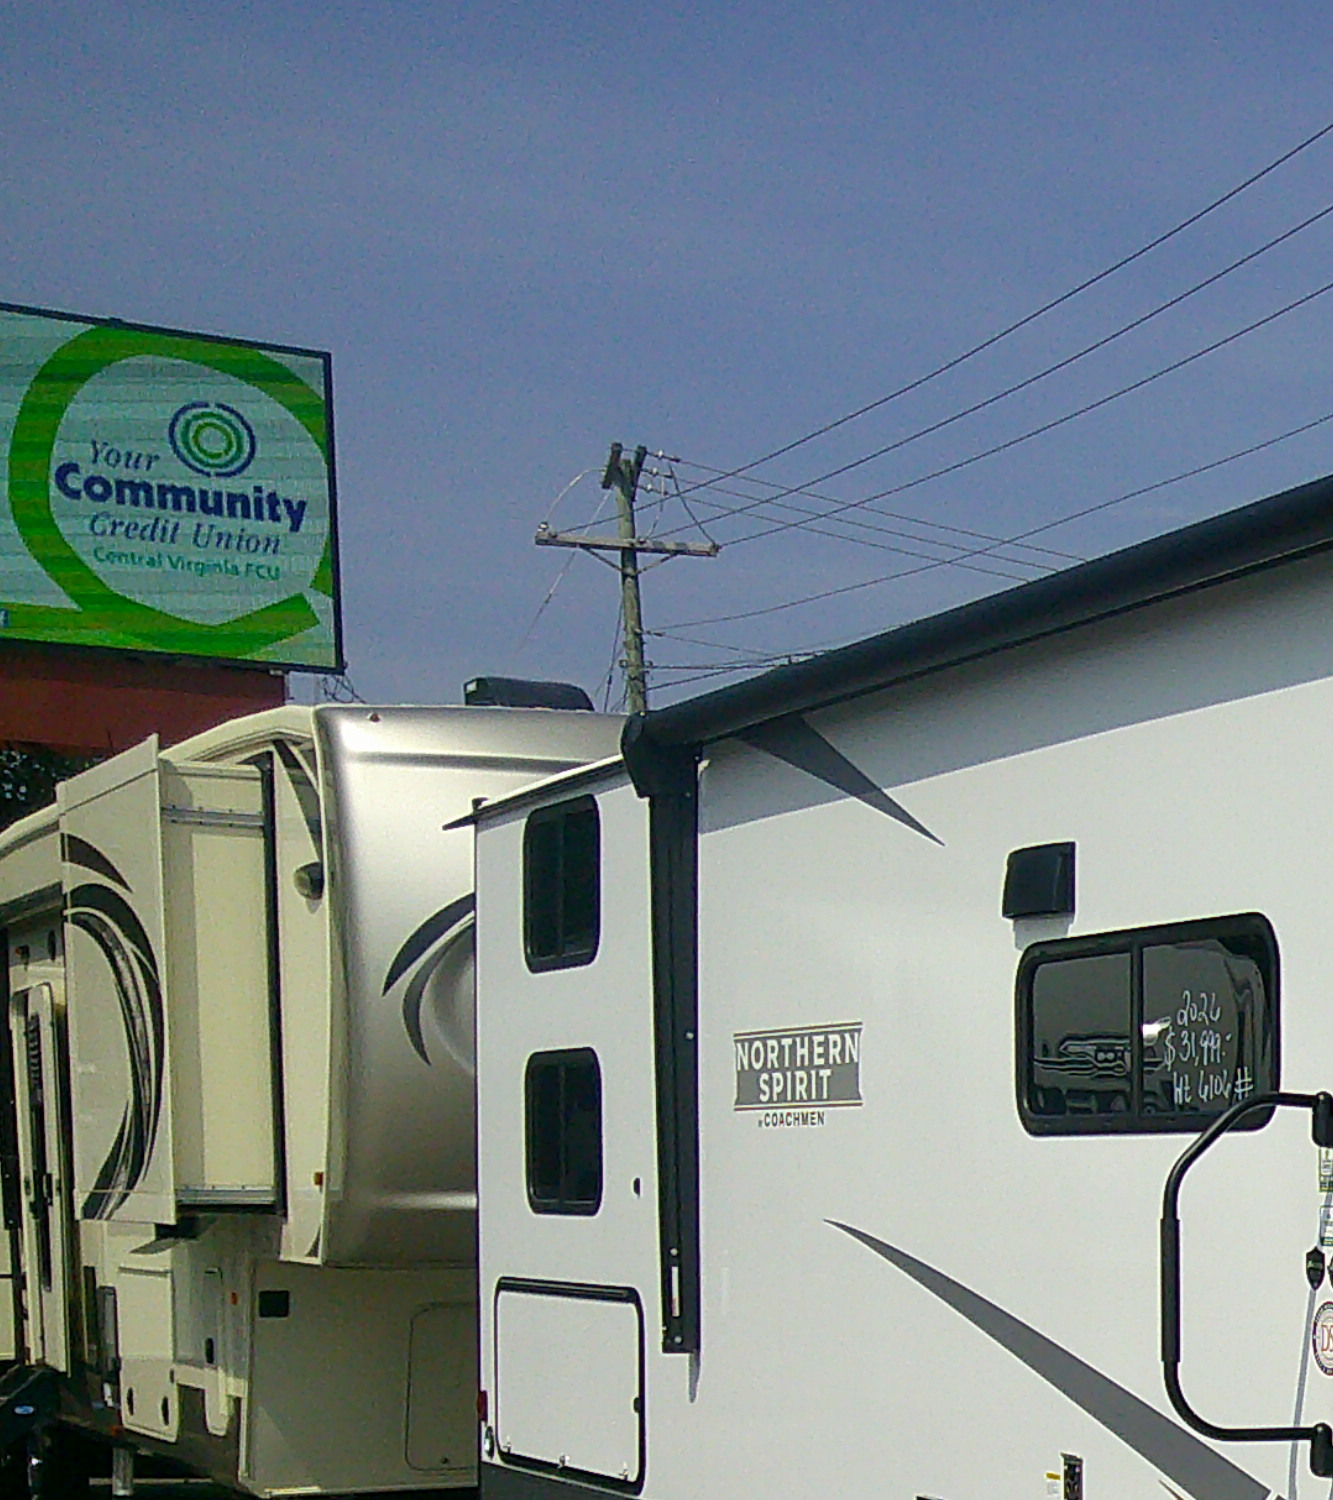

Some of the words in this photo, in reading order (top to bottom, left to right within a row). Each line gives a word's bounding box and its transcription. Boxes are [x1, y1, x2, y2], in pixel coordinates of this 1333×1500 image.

[91, 438, 160, 472] Your
[54, 462, 307, 533] Community
[89, 510, 181, 545] Credit
[192, 524, 281, 555] Union
[93, 545, 163, 568] Central
[166, 553, 240, 577] Virginia
[244, 562, 281, 582] FCU
[736, 1032, 859, 1071] NORTHERN
[759, 1069, 832, 1103] SPIRIT
[764, 1110, 825, 1127] COACHMEN
